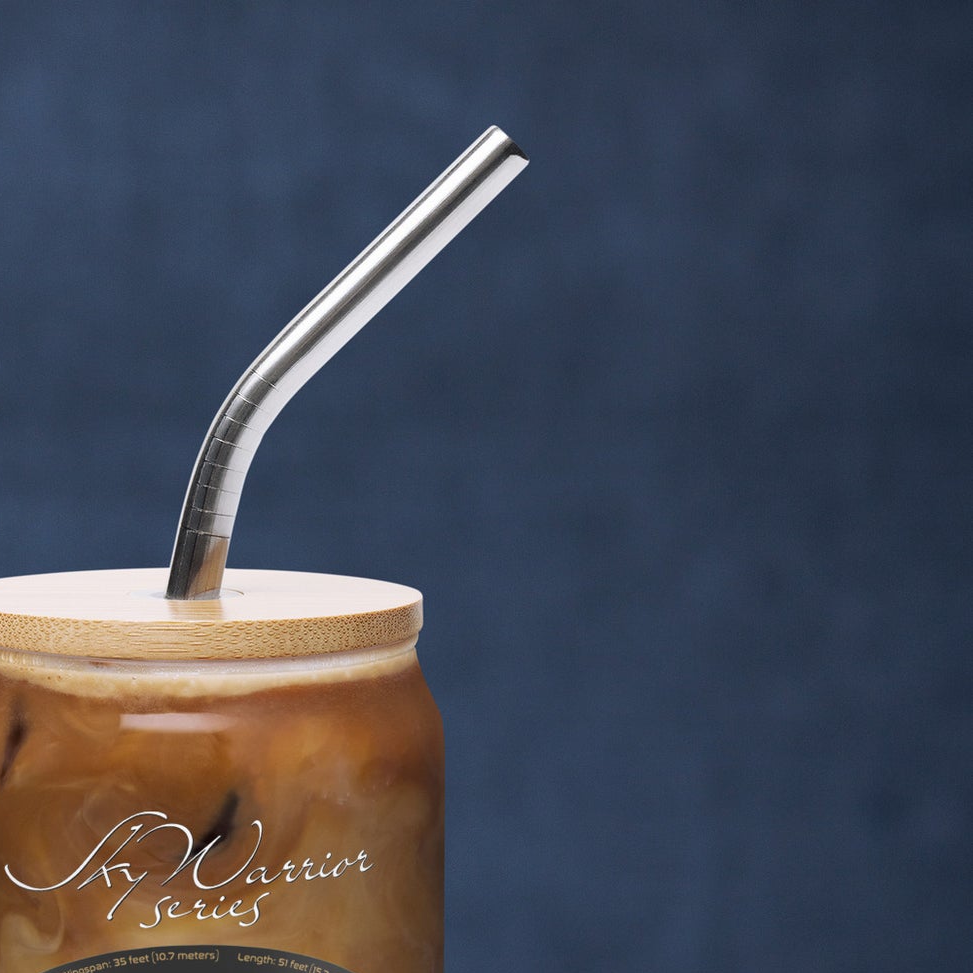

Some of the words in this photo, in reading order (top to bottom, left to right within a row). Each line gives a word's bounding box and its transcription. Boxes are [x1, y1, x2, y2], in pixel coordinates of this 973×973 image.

[4, 811, 169, 921] Sky
[137, 820, 375, 890] Warrior
[139, 892, 271, 929] series
[113, 957, 127, 967] 35
[128, 954, 150, 965] feet
[151, 951, 175, 964] (10.7
[177, 949, 220, 963] meters)
[237, 953, 276, 965] Length:
[278, 958, 289, 967] 51
[289, 960, 308, 972] feet
